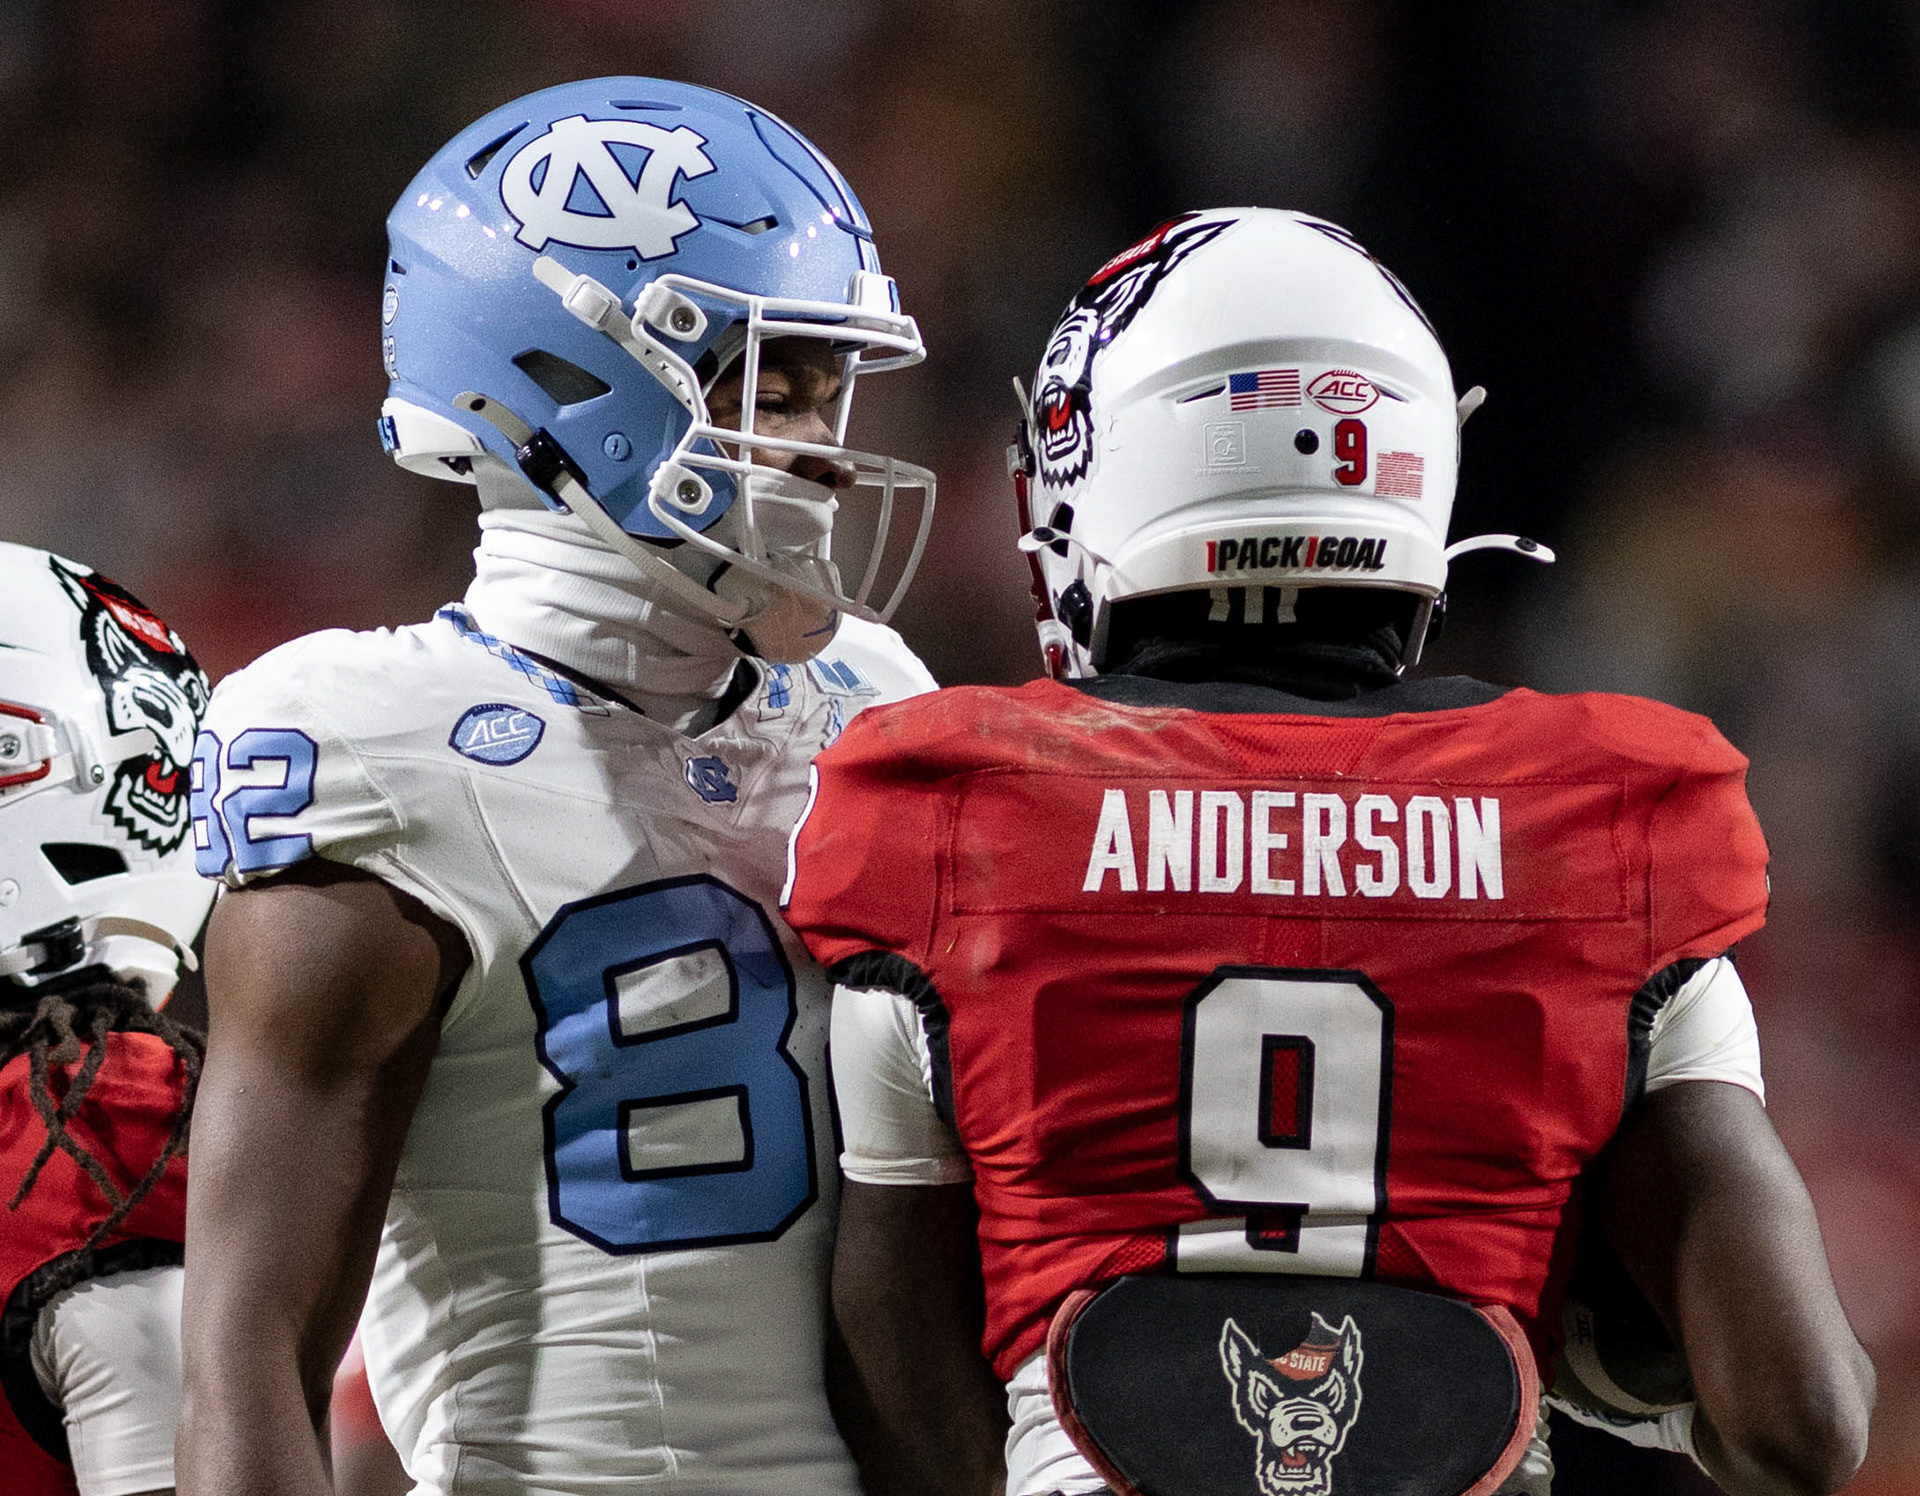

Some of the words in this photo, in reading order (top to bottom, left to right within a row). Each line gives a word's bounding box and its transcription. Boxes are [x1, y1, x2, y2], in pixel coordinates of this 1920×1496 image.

[1319, 380, 1370, 398] ACC
[1332, 418, 1368, 487] 9
[465, 712, 530, 747] ACC
[189, 728, 318, 878] 82
[1082, 789, 1504, 900] ANDERSON
[1166, 964, 1396, 1280] 9
[1288, 1352, 1327, 1373] STATE
